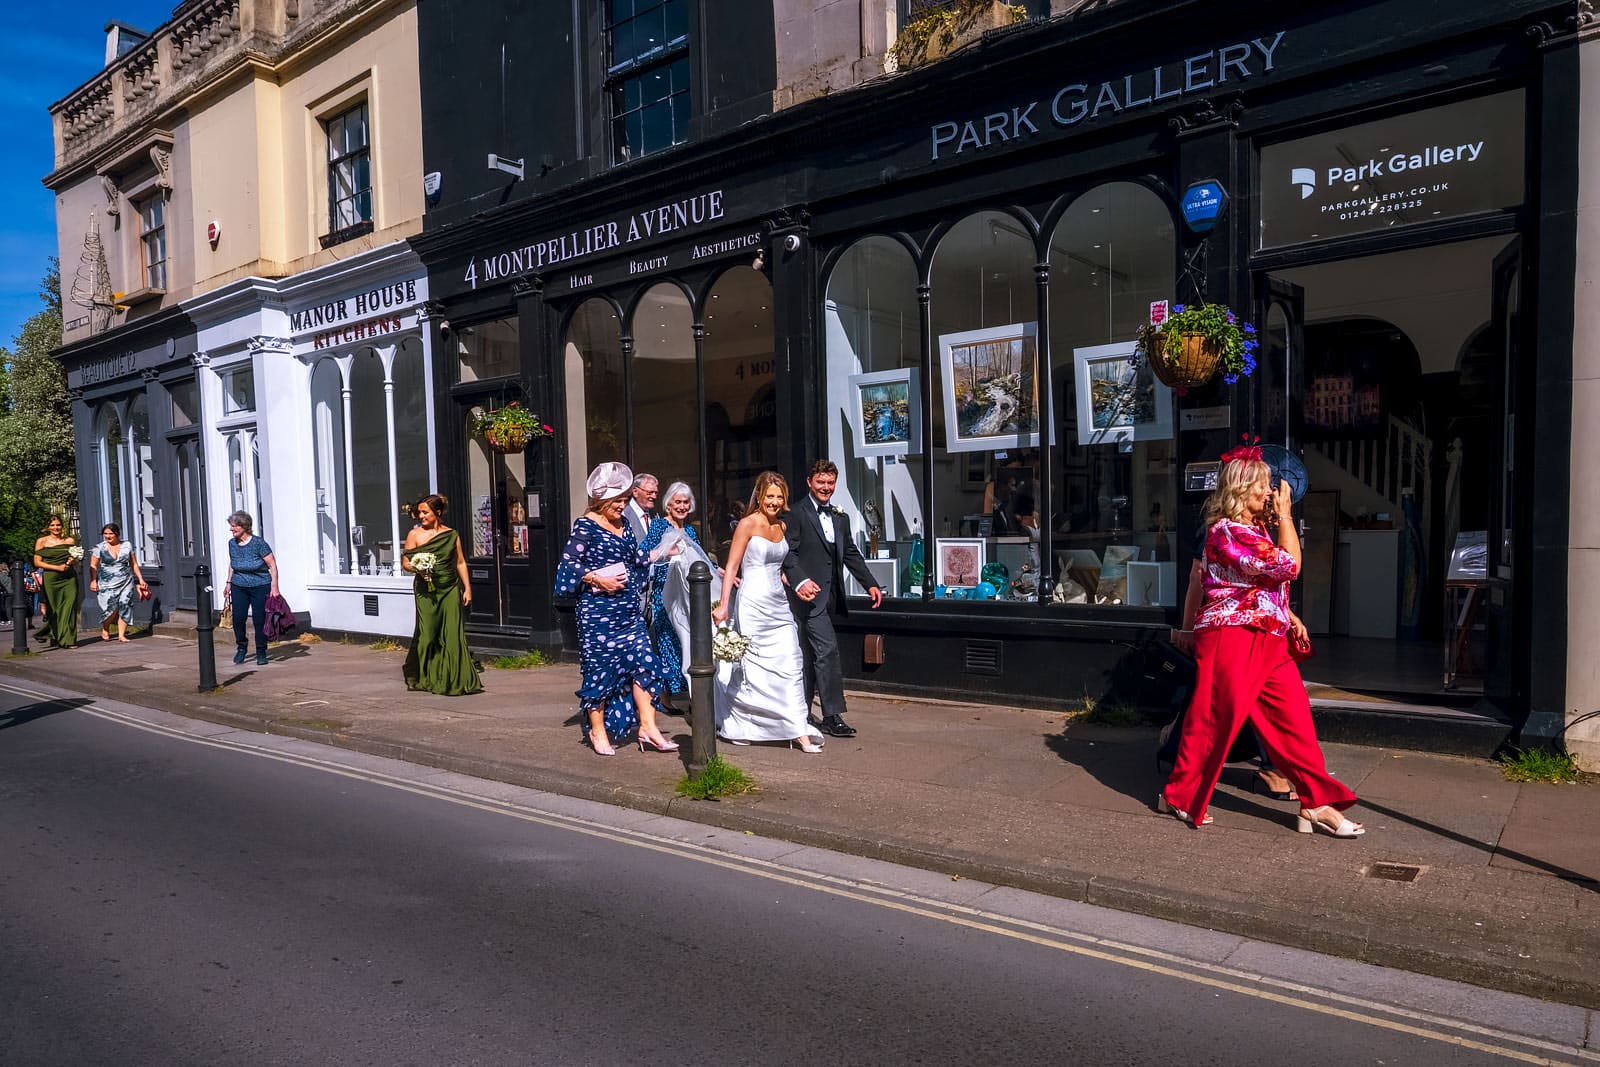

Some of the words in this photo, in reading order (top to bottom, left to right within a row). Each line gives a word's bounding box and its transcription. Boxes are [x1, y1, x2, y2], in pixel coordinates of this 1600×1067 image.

[931, 102, 1039, 161] PARK
[1051, 31, 1286, 126] GALLERY
[1328, 159, 1383, 186] Park
[1389, 141, 1484, 173] Gallery
[1321, 182, 1449, 213] PARKGALLERY.CO.UK
[1340, 207, 1375, 220] 01242
[1379, 199, 1422, 214] 228325
[464, 255, 478, 290] 4
[484, 222, 620, 282] MONTPELLIER
[626, 190, 724, 243] AVENUE
[289, 299, 348, 333] MANOR
[355, 279, 416, 316] HOUSE
[313, 314, 402, 350] KITCHENS
